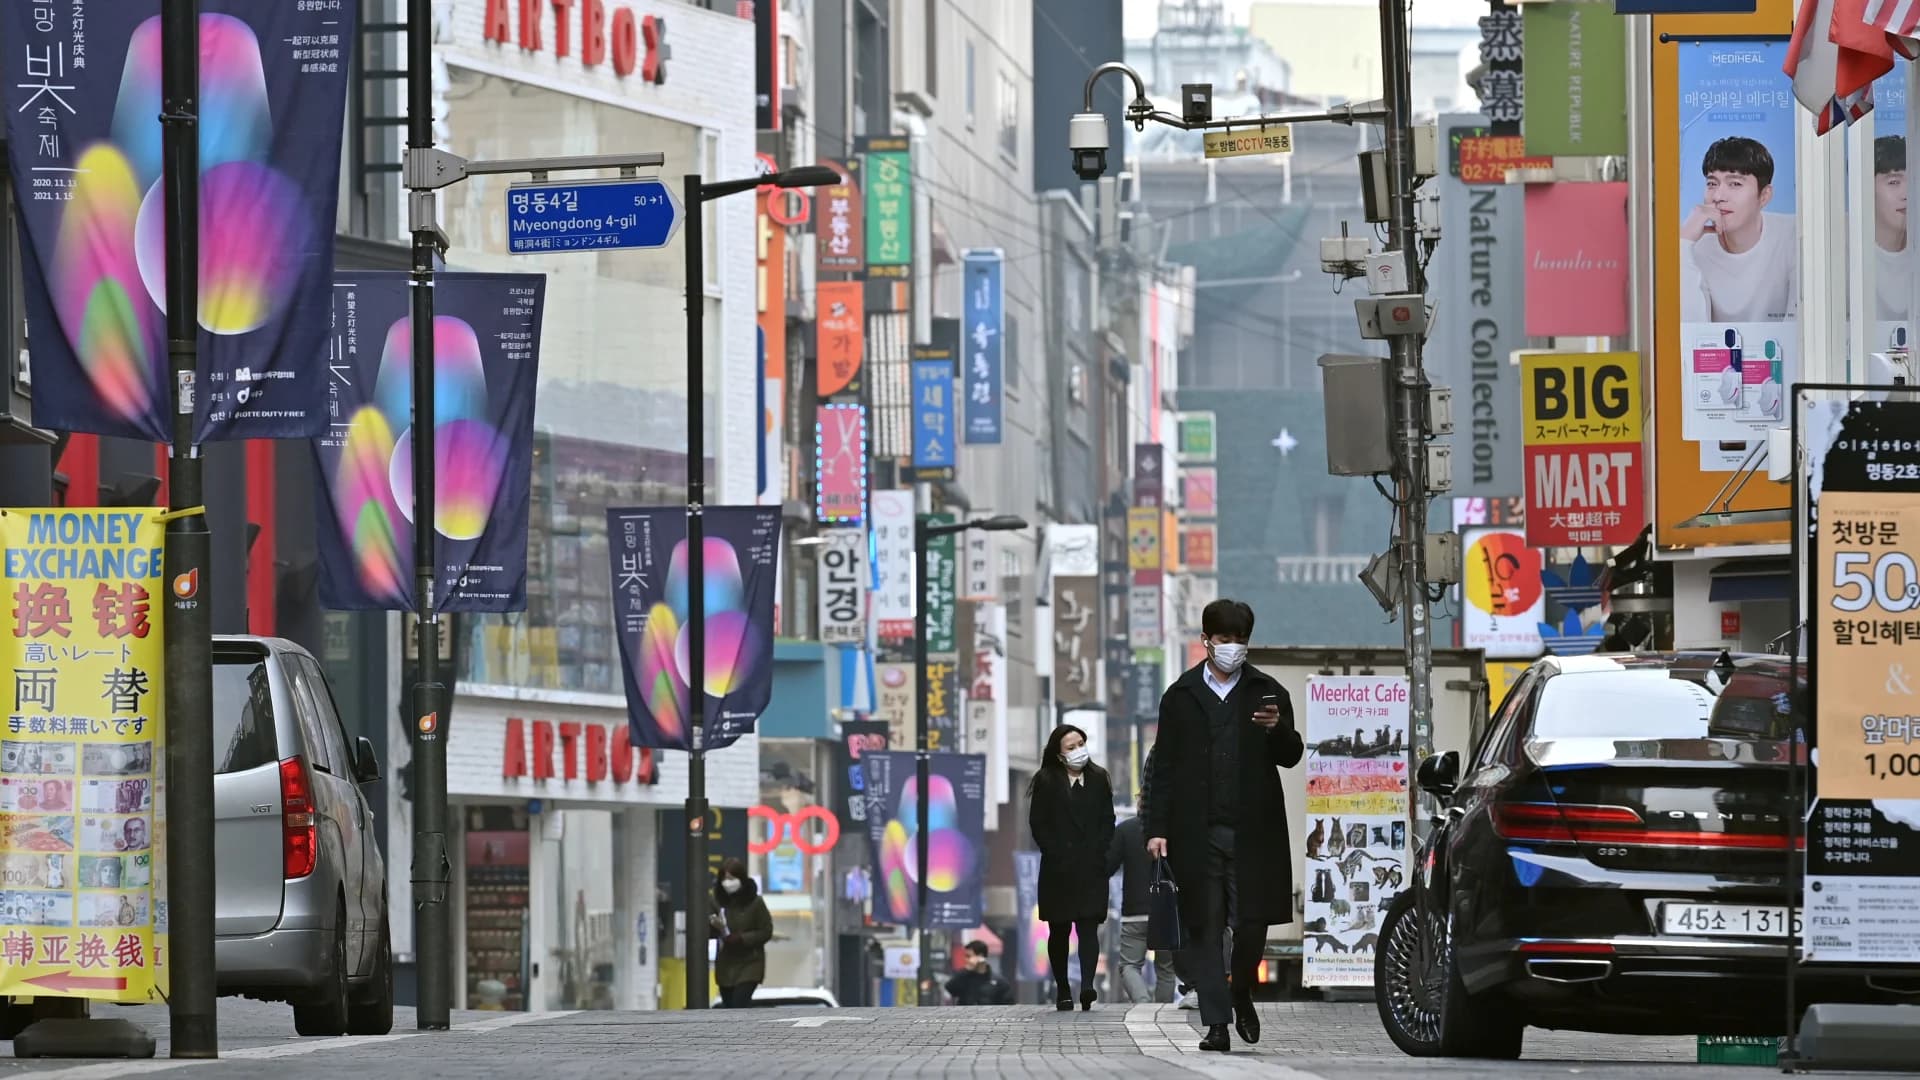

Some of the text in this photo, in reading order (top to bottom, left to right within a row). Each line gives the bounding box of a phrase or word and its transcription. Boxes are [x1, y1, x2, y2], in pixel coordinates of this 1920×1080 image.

[72, 0, 86, 69] 之灯光庆典
[1712, 54, 1764, 65] MEDIHEAL
[1685, 90, 1789, 109] 매일매일 메디힐
[1219, 134, 1290, 153] 방범CCTV작동중
[512, 190, 579, 214] 명동4길
[634, 196, 647, 206] 50
[513, 214, 637, 233] Myeongdong 4-gil
[1469, 189, 1499, 486] Nature Collection
[1533, 364, 1630, 421] BIG
[1536, 423, 1631, 440] スーパーマーケット
[1534, 452, 1633, 509] MART
[1866, 463, 1920, 481] 명동2호
[27, 513, 144, 545] MONEY
[1550, 512, 1621, 529] 大型超市
[1568, 531, 1603, 542] 빅마트
[1832, 519, 1900, 546] 첫방문
[4, 547, 163, 580] EXCHANGE
[25, 643, 131, 663] 高いレート
[1885, 662, 1913, 695] &
[1311, 683, 1406, 702] Meerkat Cafe
[1328, 706, 1389, 718] 미어캣 카페
[7, 716, 149, 735] 手数料無いです
[251, 804, 272, 814] VGT
[1669, 811, 1780, 822] GENES
[1677, 908, 1727, 931] 45소
[1, 929, 145, 969] 韩亚换钱
